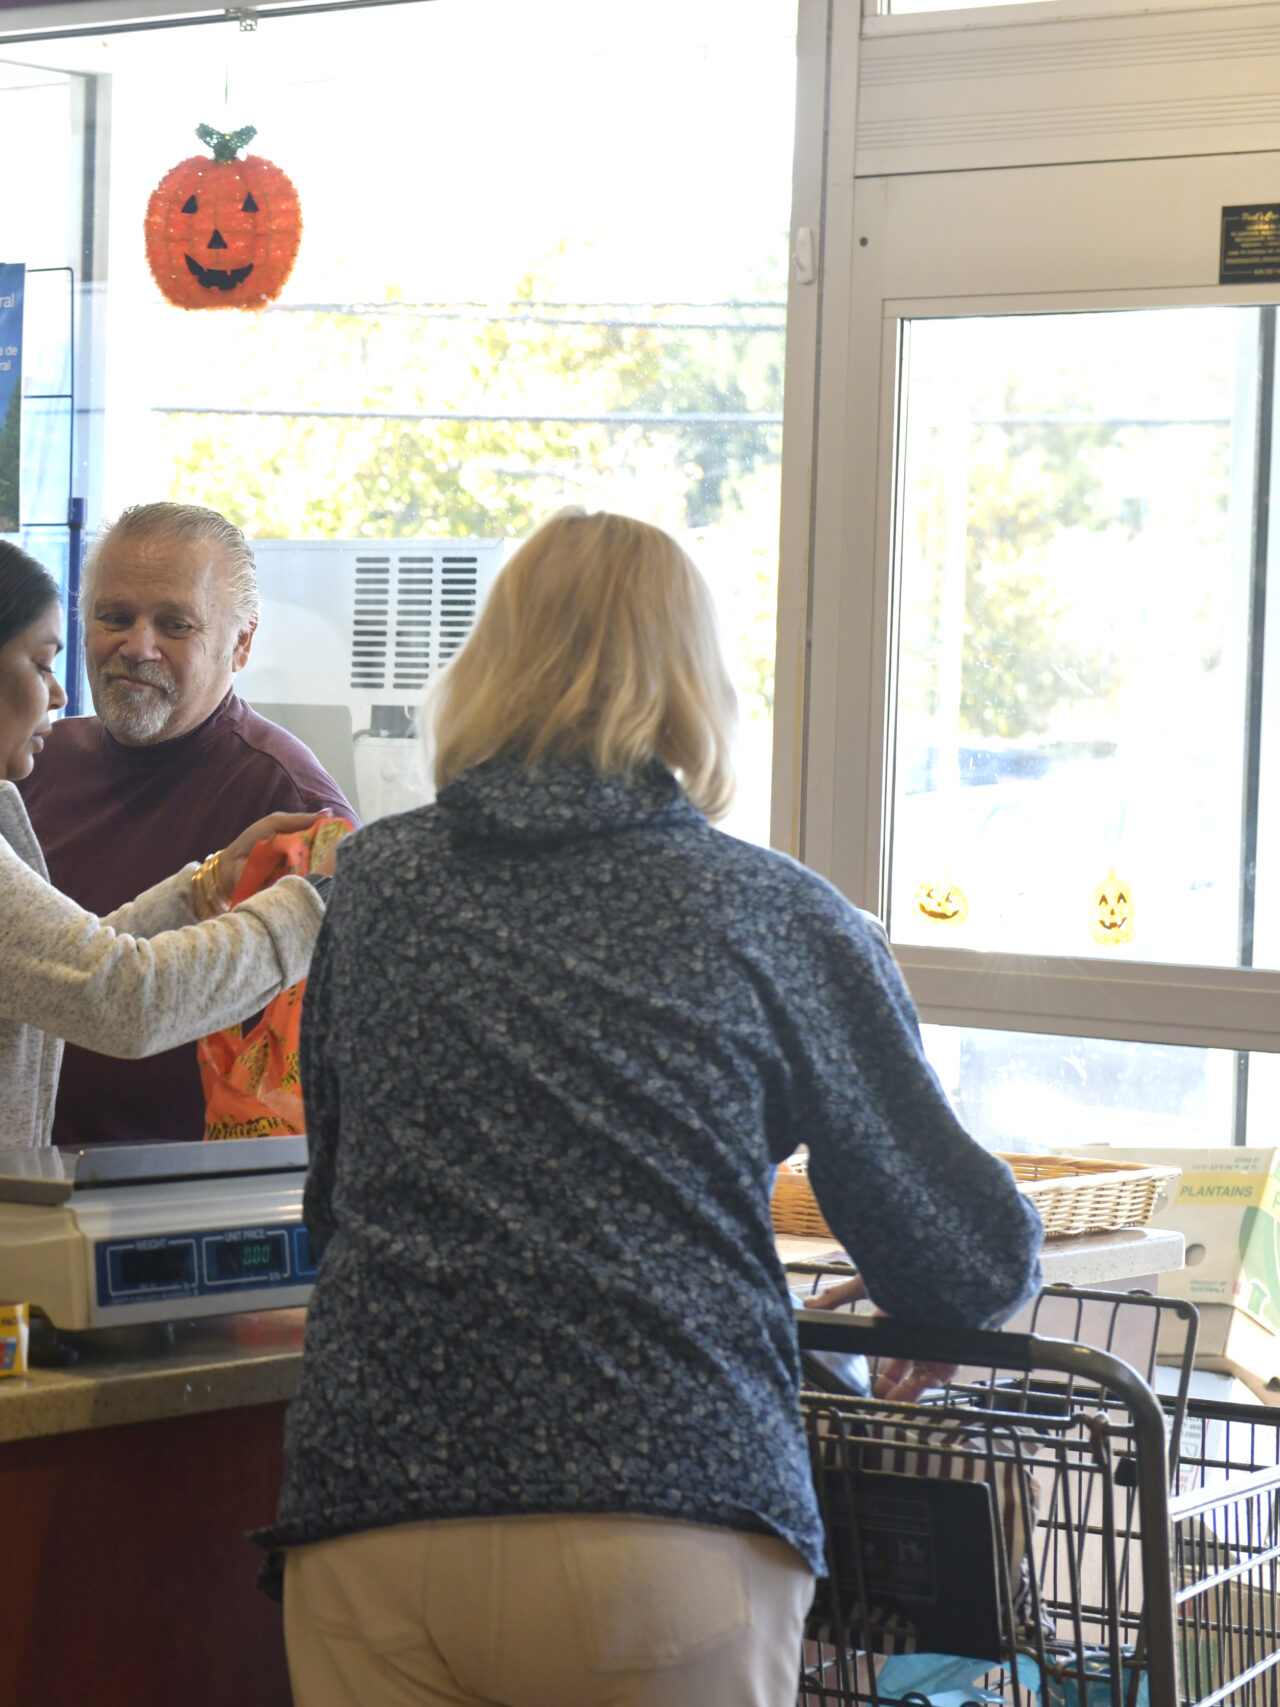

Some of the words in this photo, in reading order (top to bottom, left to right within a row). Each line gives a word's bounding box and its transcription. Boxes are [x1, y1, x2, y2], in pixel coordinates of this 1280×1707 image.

[5, 344, 18, 356] de
[1179, 1185, 1253, 1198] PLANTAINS
[223, 1230, 242, 1242] UNIT
[243, 1228, 266, 1240] PRICE
[135, 1238, 167, 1250] WEIGHT
